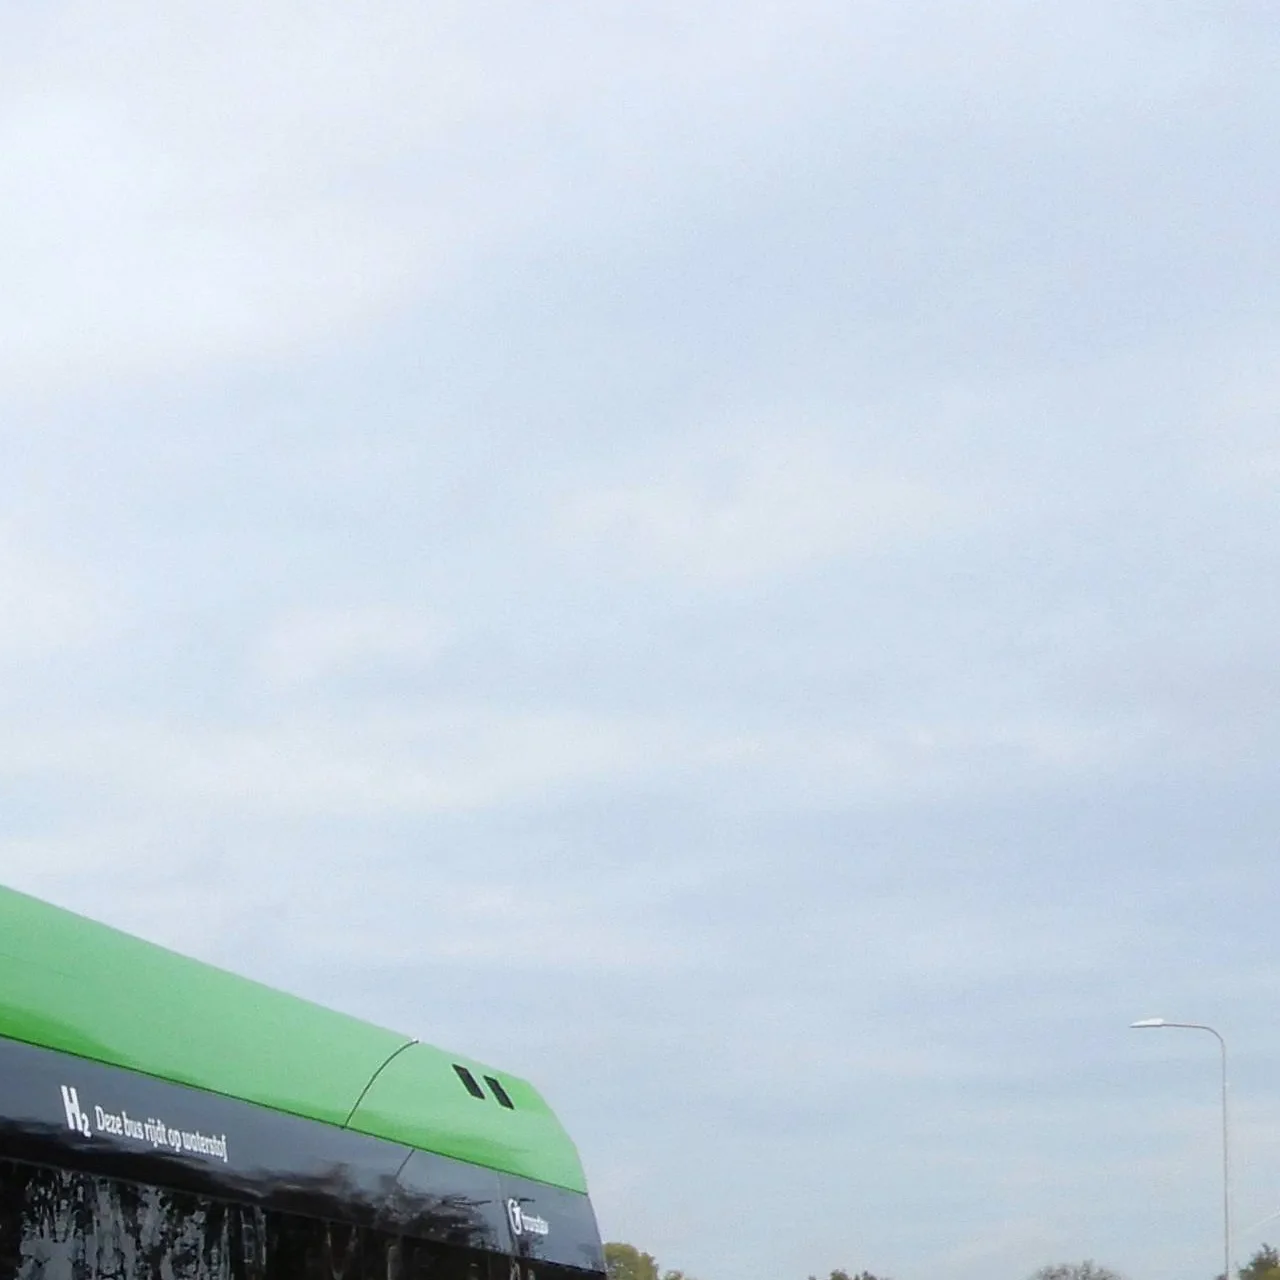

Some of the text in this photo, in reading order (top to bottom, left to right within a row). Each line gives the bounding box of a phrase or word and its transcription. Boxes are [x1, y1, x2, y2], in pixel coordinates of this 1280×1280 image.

[95, 1105, 229, 1163] Deze bus rijdt op waterstof
